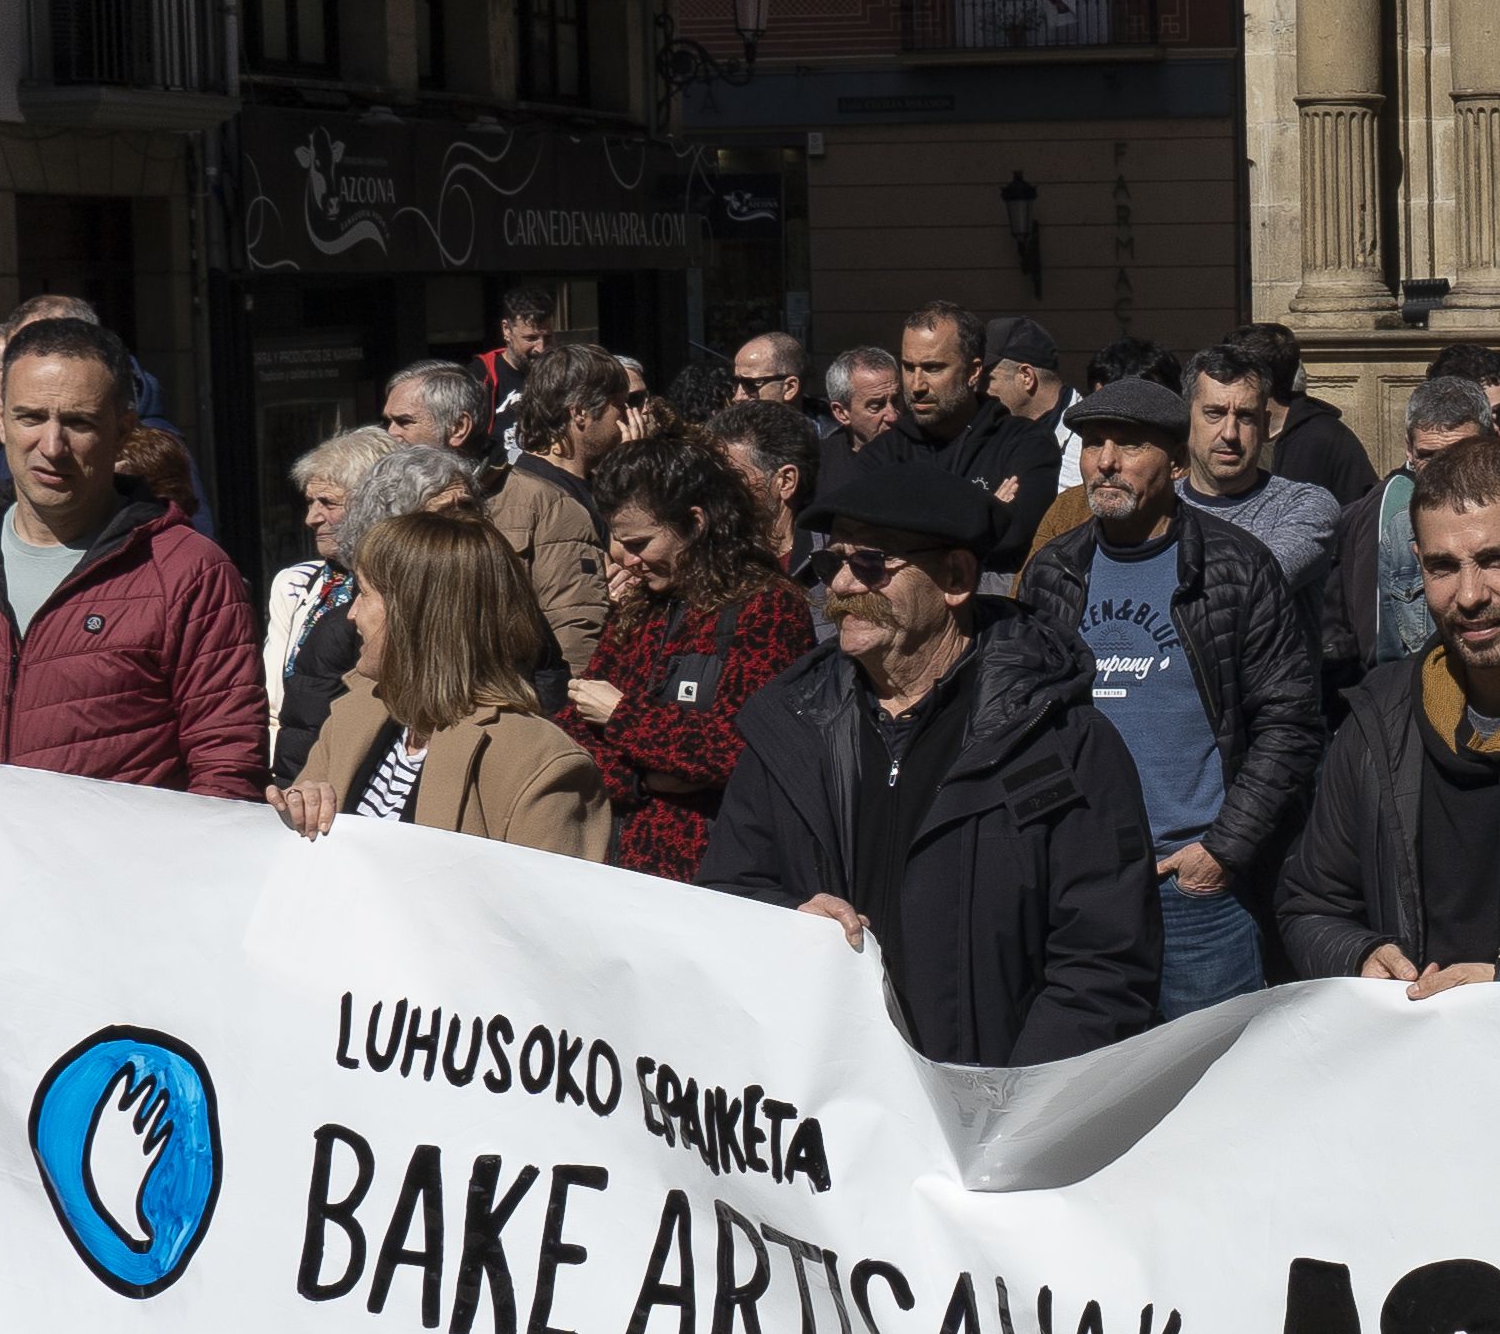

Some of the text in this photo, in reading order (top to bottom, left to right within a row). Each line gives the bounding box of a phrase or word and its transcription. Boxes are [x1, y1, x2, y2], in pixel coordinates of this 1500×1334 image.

[339, 175, 397, 204] AZCONA
[503, 208, 687, 247] CARNEDENAVARRA.COM
[336, 991, 831, 1194] LUHUSOKO EPAIKETA
